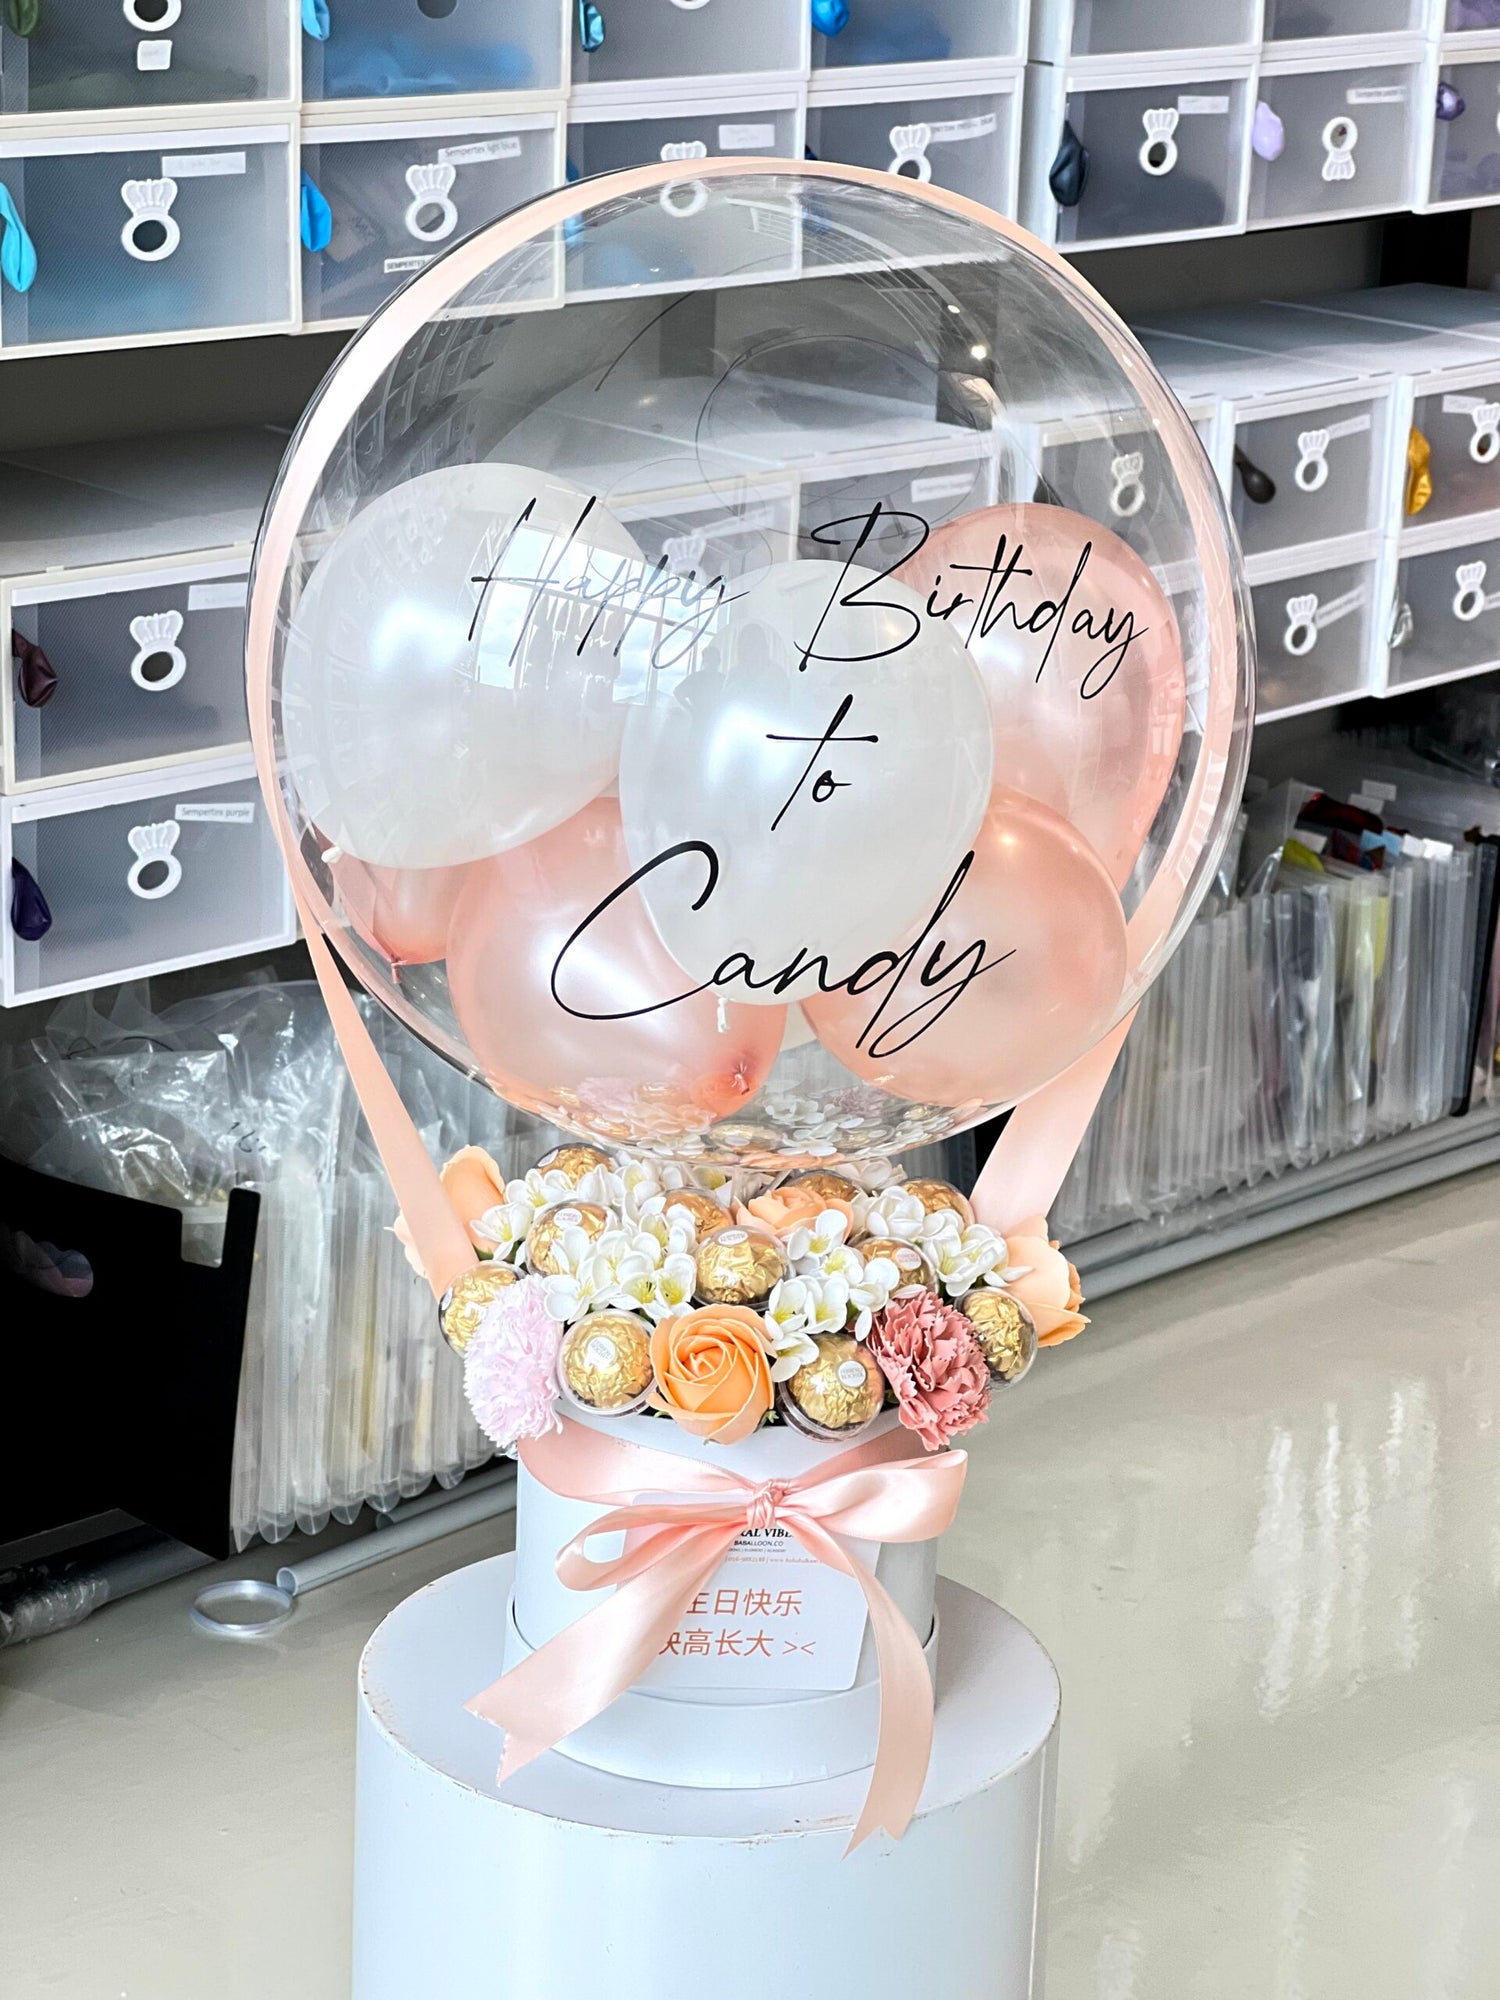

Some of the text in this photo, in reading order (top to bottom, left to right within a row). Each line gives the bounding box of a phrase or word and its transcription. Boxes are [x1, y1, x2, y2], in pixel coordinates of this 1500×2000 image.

[468, 496, 1149, 700] Happy Birthday
[765, 694, 879, 832] to
[550, 839, 1017, 1058] Candy
